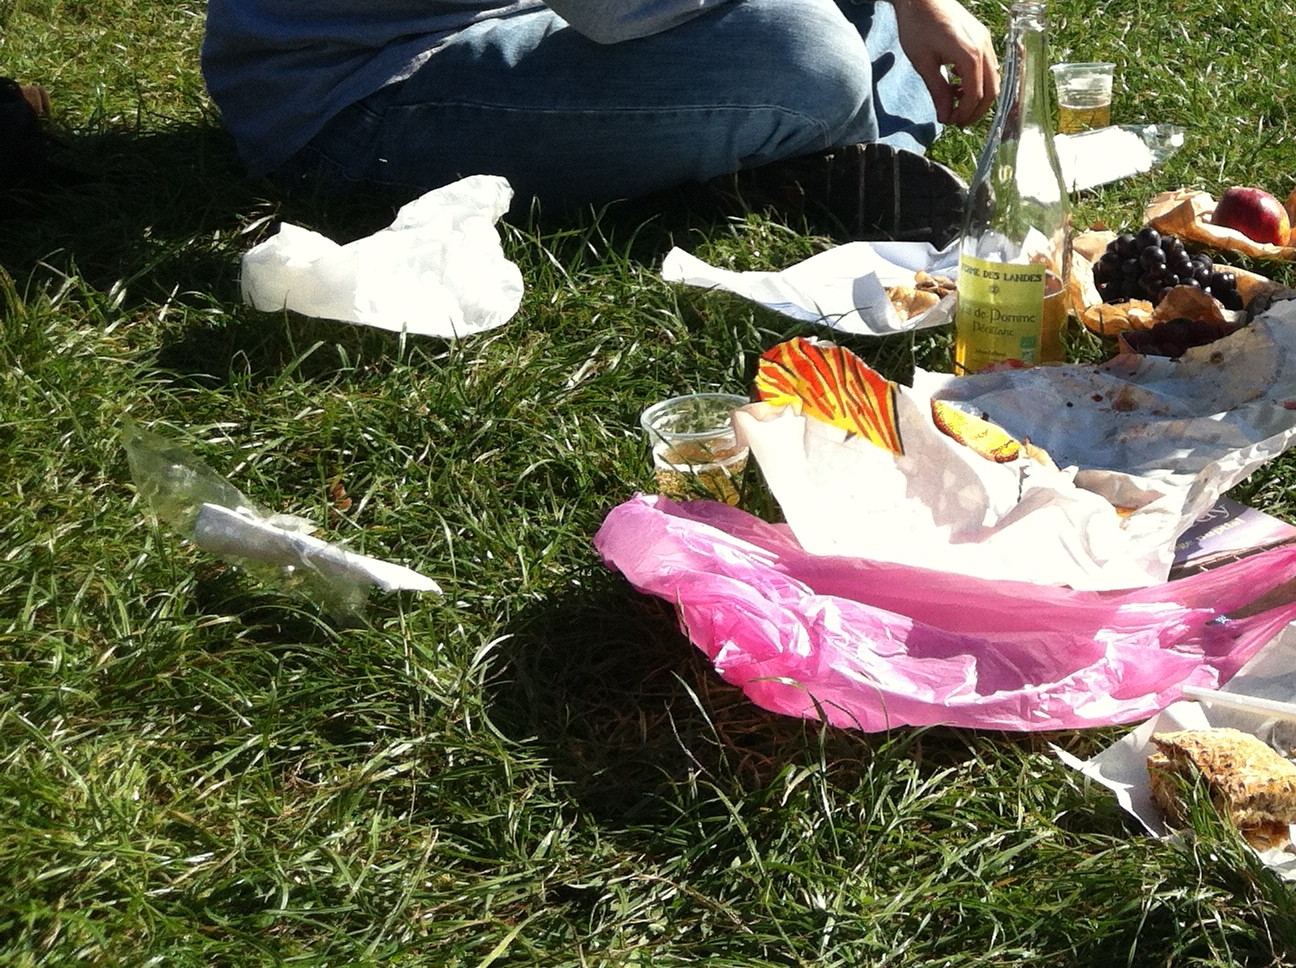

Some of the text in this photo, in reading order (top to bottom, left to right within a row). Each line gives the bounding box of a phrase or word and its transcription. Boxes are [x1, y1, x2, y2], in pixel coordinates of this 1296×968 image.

[983, 270, 1000, 280] DES
[1003, 273, 1043, 283] LANDES
[974, 307, 987, 320] de
[990, 307, 1036, 325] Pomme
